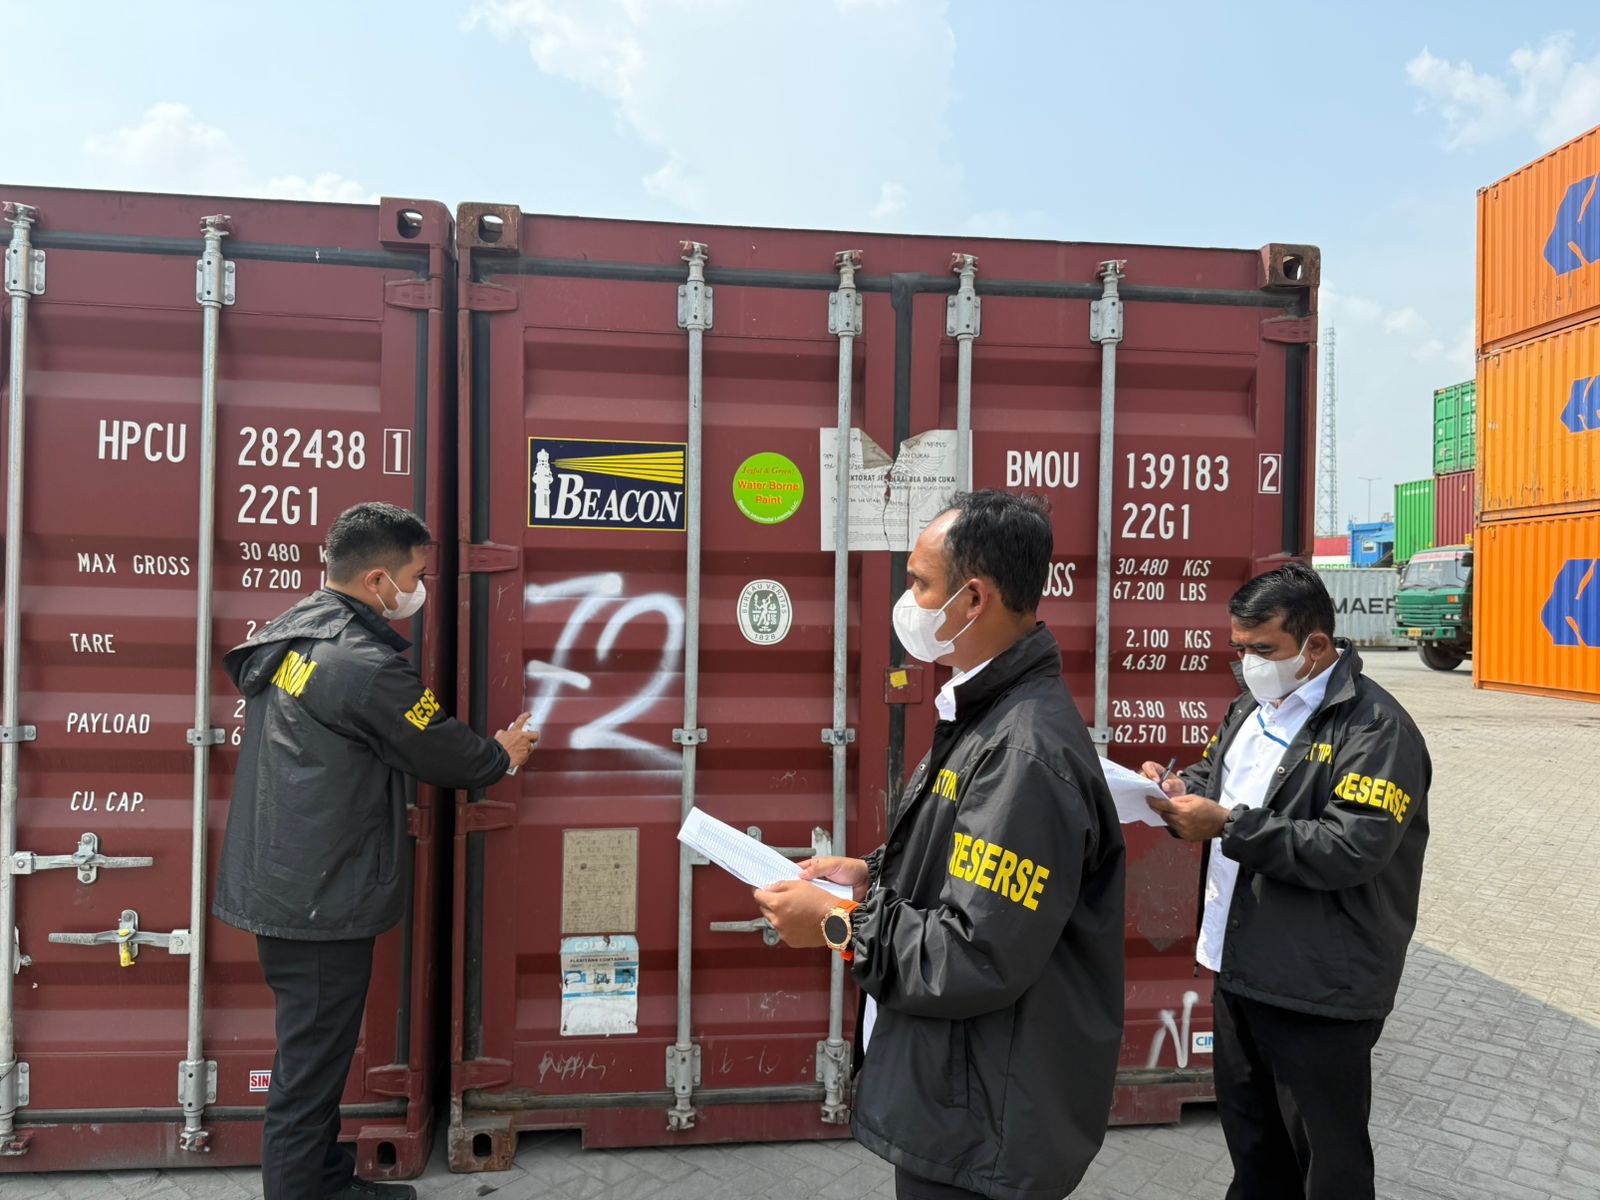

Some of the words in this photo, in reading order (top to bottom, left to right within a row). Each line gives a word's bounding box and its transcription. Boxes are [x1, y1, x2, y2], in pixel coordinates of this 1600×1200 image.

[98, 419, 187, 463] HPCU
[238, 426, 366, 470] 282438
[391, 431, 403, 473] 1
[1006, 450, 1079, 489] BMOU
[1126, 452, 1229, 492] 139183
[1261, 455, 1280, 493] 2
[738, 479, 767, 490] Water
[769, 480, 800, 491] Borne
[237, 483, 318, 526] 22G1
[551, 473, 683, 523] BEACON
[755, 495, 783, 505] Paint
[1121, 502, 1190, 540] 22G1
[77, 552, 117, 574] MAX
[133, 554, 190, 576] GROSS
[239, 541, 262, 561] 30
[267, 543, 300, 562] 480
[1115, 557, 1169, 576] 30.480
[1182, 559, 1212, 577] KGS
[241, 567, 264, 588] 67
[269, 568, 301, 590] 200
[742, 583, 763, 614] BUREAU
[766, 583, 787, 615] VERITAS
[1113, 581, 1165, 601] 67.200
[1180, 582, 1207, 602] LBS
[69, 632, 116, 653] TARE
[1126, 628, 1169, 648] 2.100
[1184, 629, 1211, 649] KGS
[1122, 653, 1167, 671] 4.630
[1180, 654, 1209, 672] LBS
[1112, 700, 1165, 719] 28.380
[1178, 701, 1208, 719] KGS
[67, 712, 151, 734] PAYLOAD
[1114, 724, 1167, 744] 62.570
[1181, 724, 1210, 745] LBS
[70, 790, 98, 812] CU.
[105, 791, 145, 812] CAP.
[948, 832, 1050, 912] RESERSE
